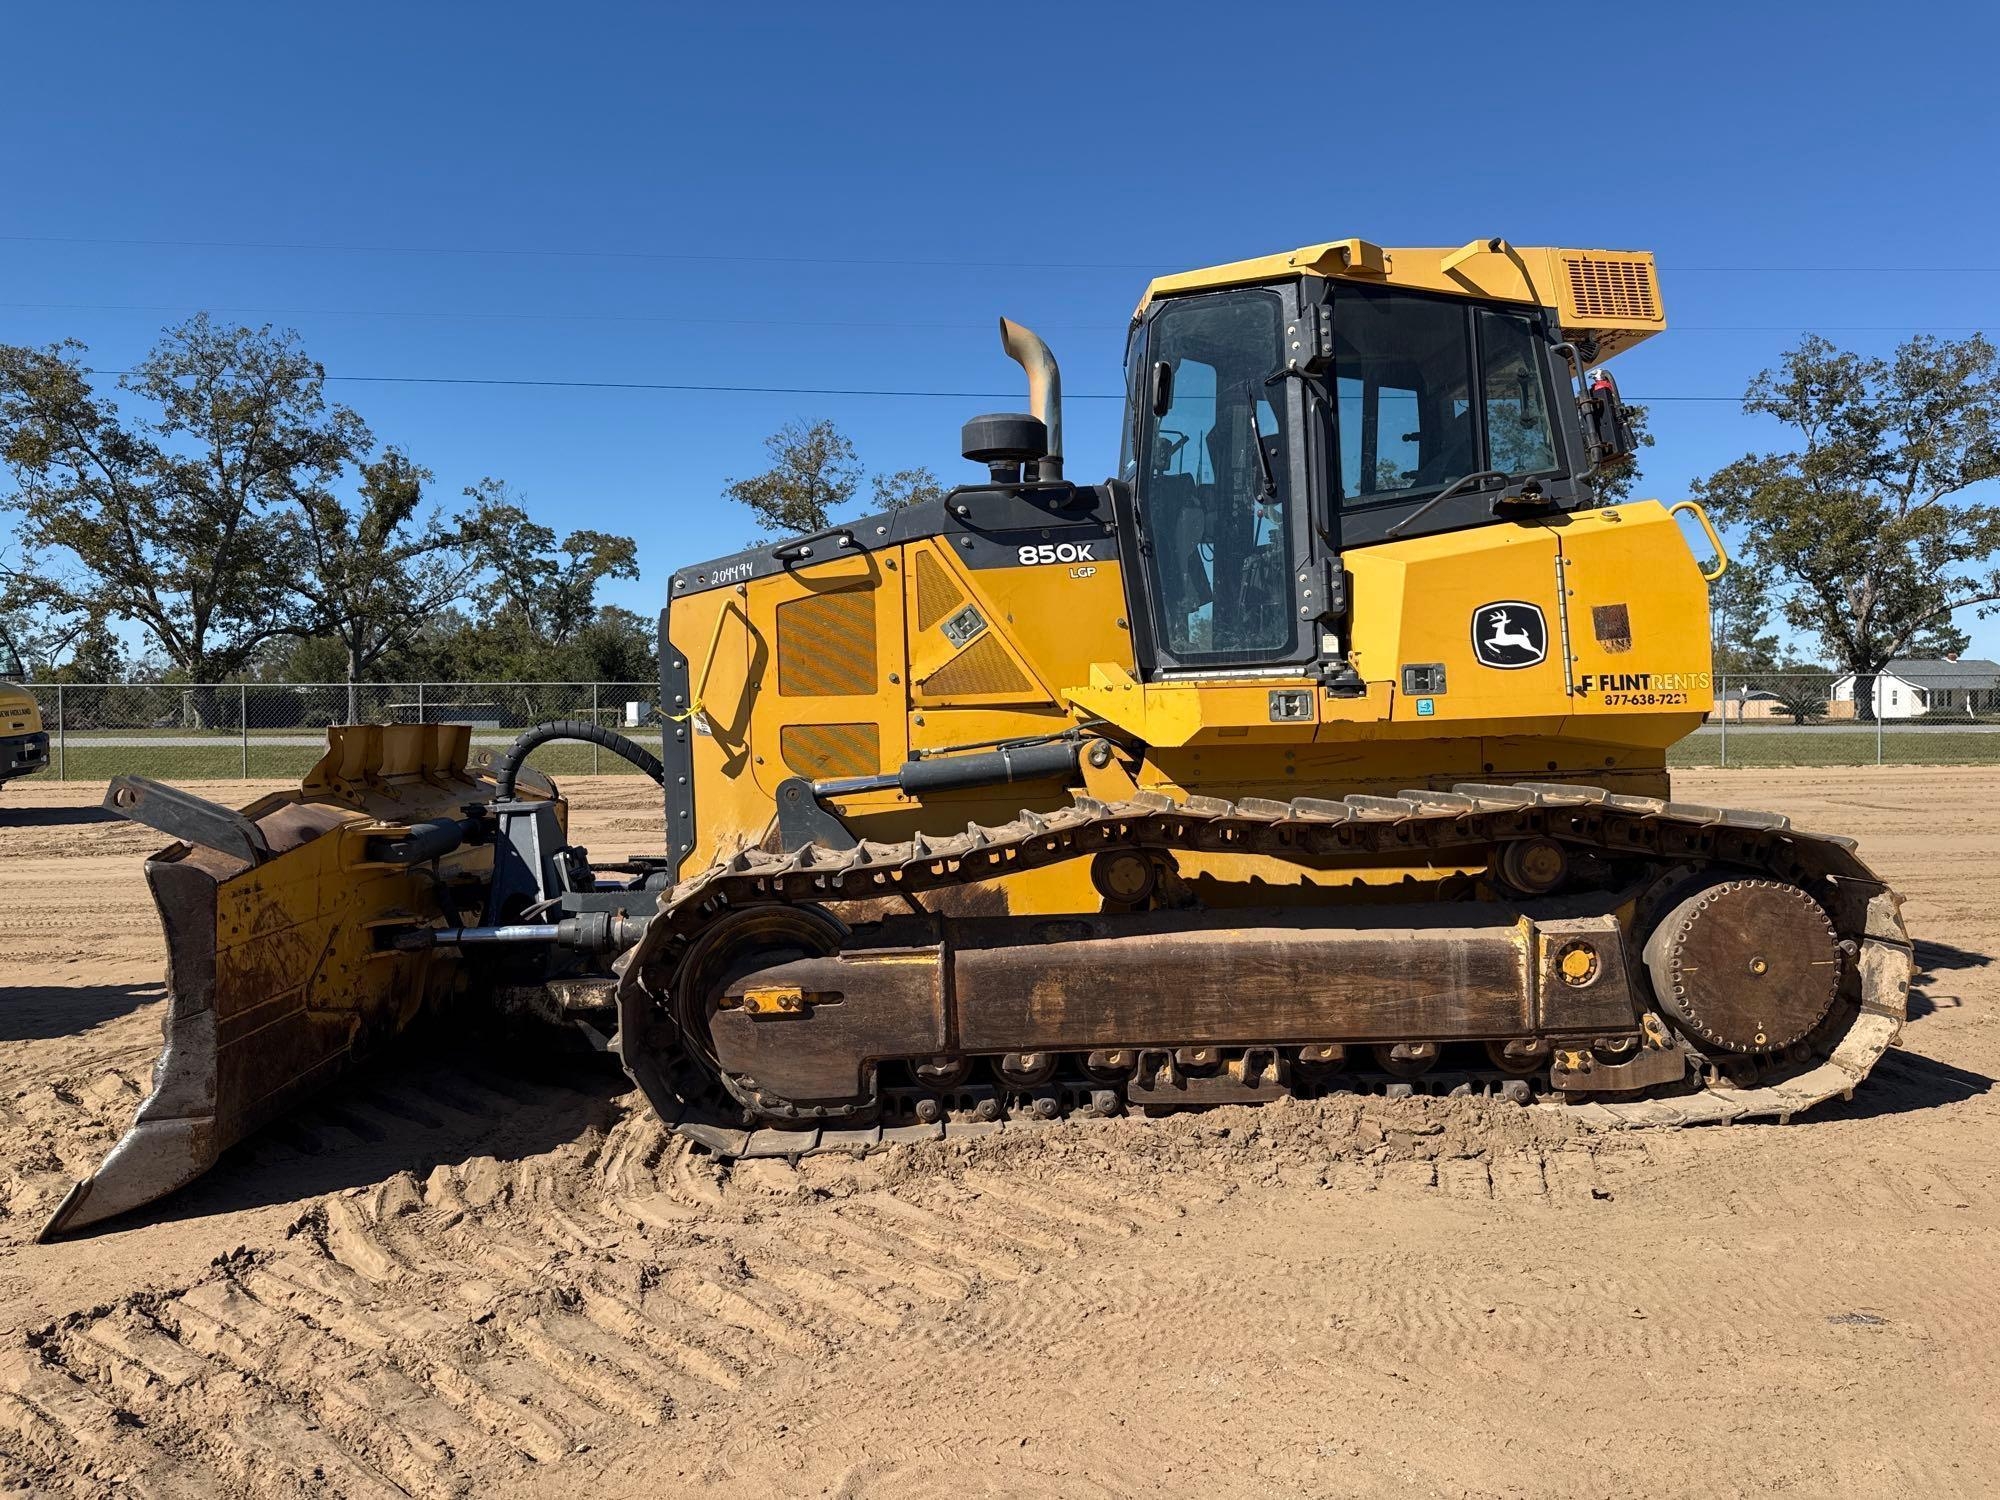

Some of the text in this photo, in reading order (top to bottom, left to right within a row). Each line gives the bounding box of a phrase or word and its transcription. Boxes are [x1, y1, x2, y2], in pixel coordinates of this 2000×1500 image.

[1018, 543, 1096, 566] 850K
[711, 561, 753, 585] 204494
[1069, 567, 1097, 579] LGP
